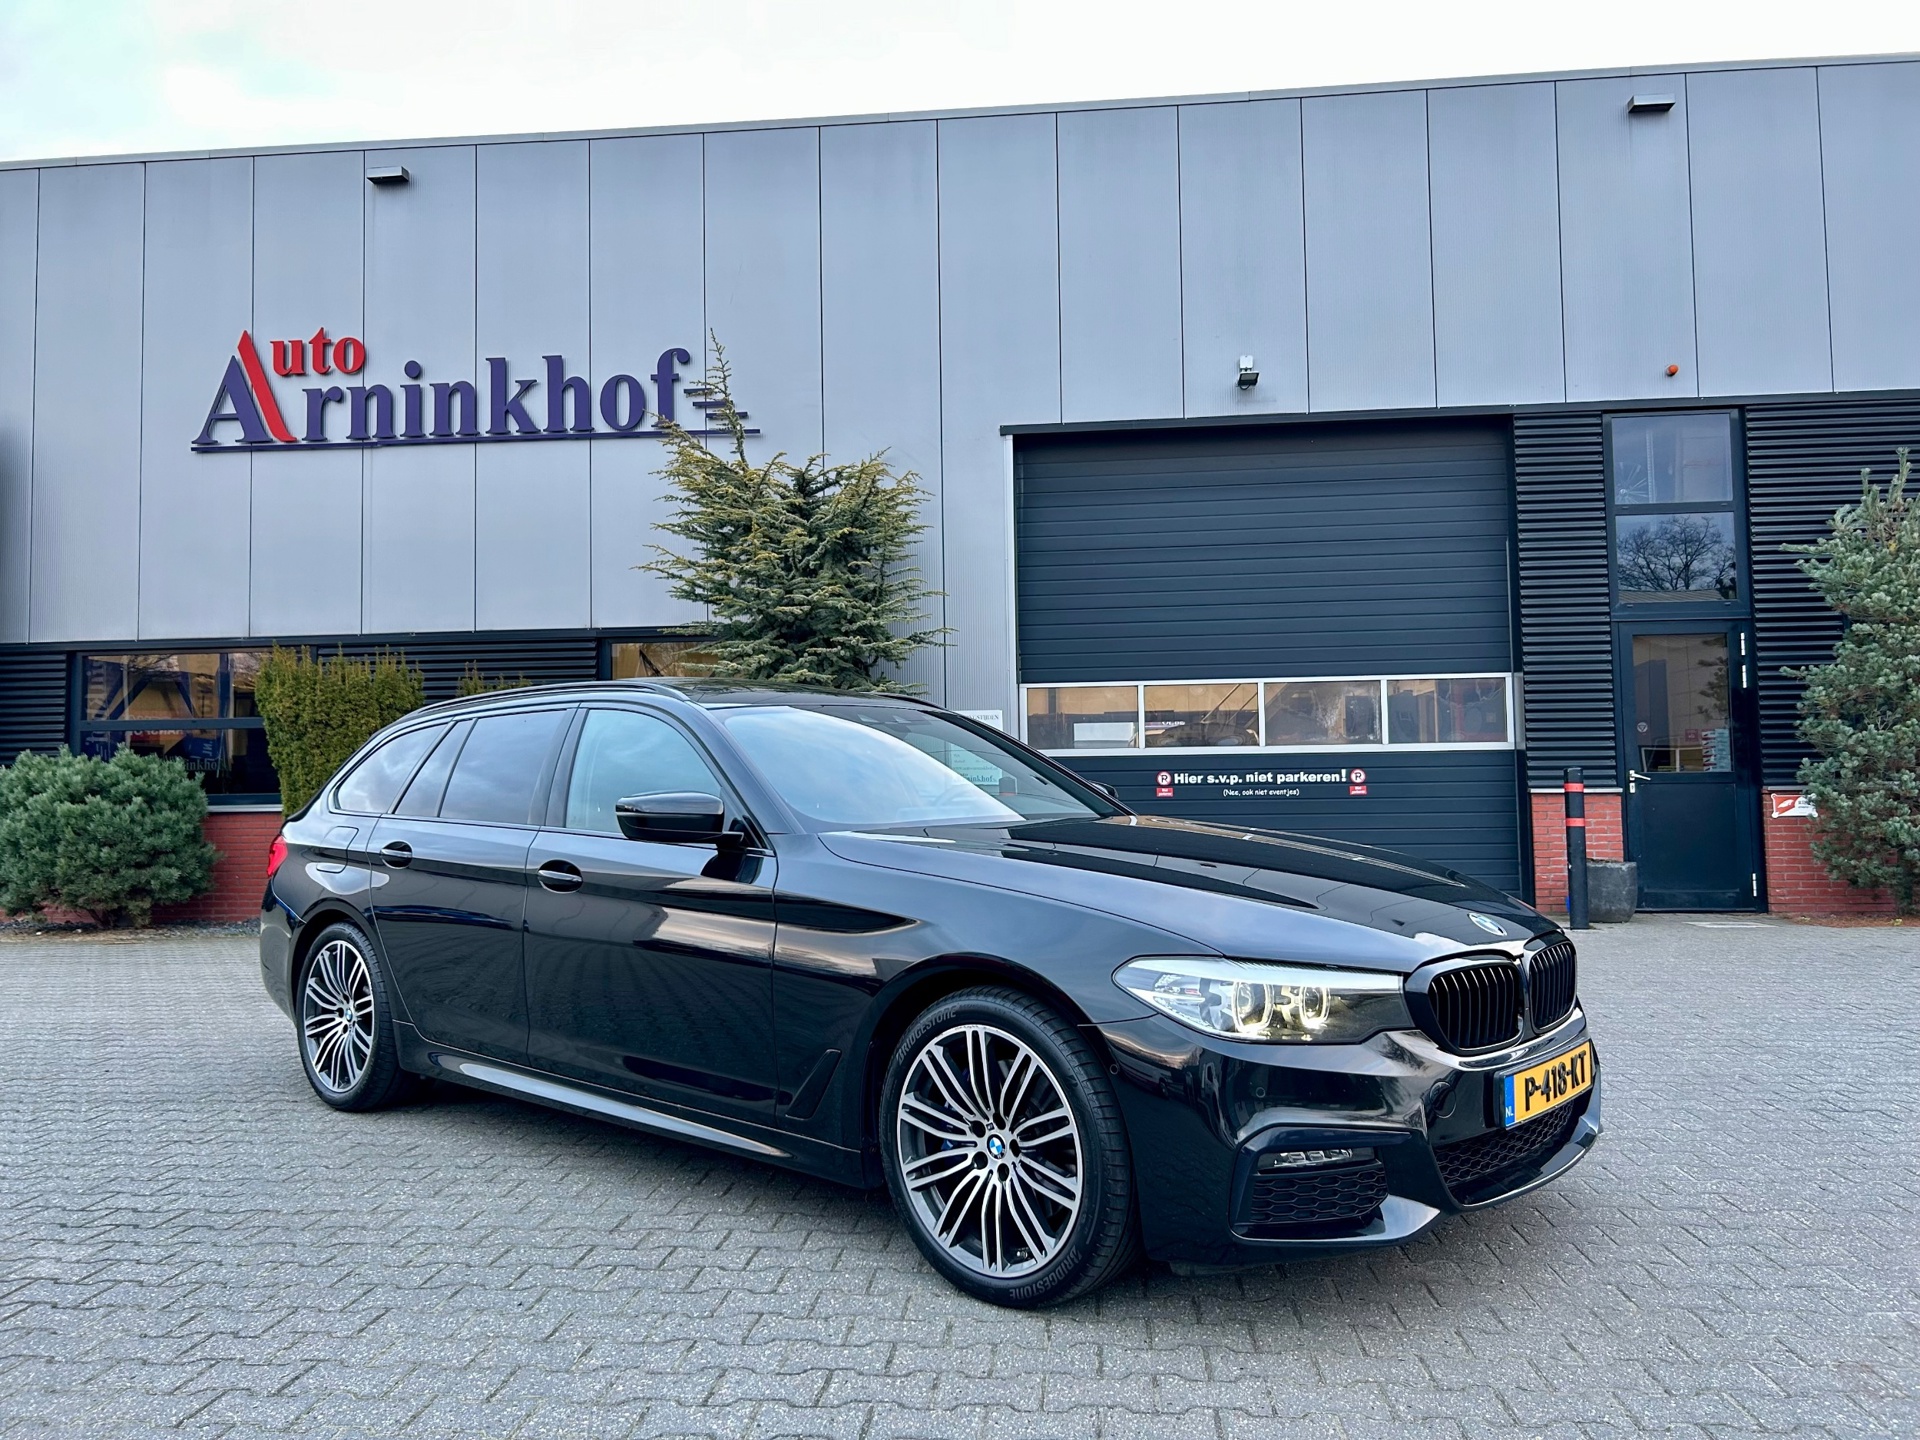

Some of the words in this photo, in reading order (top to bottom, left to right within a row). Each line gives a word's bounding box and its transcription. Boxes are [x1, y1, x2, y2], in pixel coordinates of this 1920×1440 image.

[192, 330, 690, 444] Arninkhof
[1174, 772, 1204, 784] Hier
[1207, 773, 1243, 785] s.v.p.
[1246, 771, 1274, 783] niet
[1276, 769, 1347, 784] parkeren!
[1524, 1050, 1587, 1112] P-418-KT
[1505, 1106, 1514, 1118] NL
[1009, 1245, 1083, 1300] BRIDGESTONE
